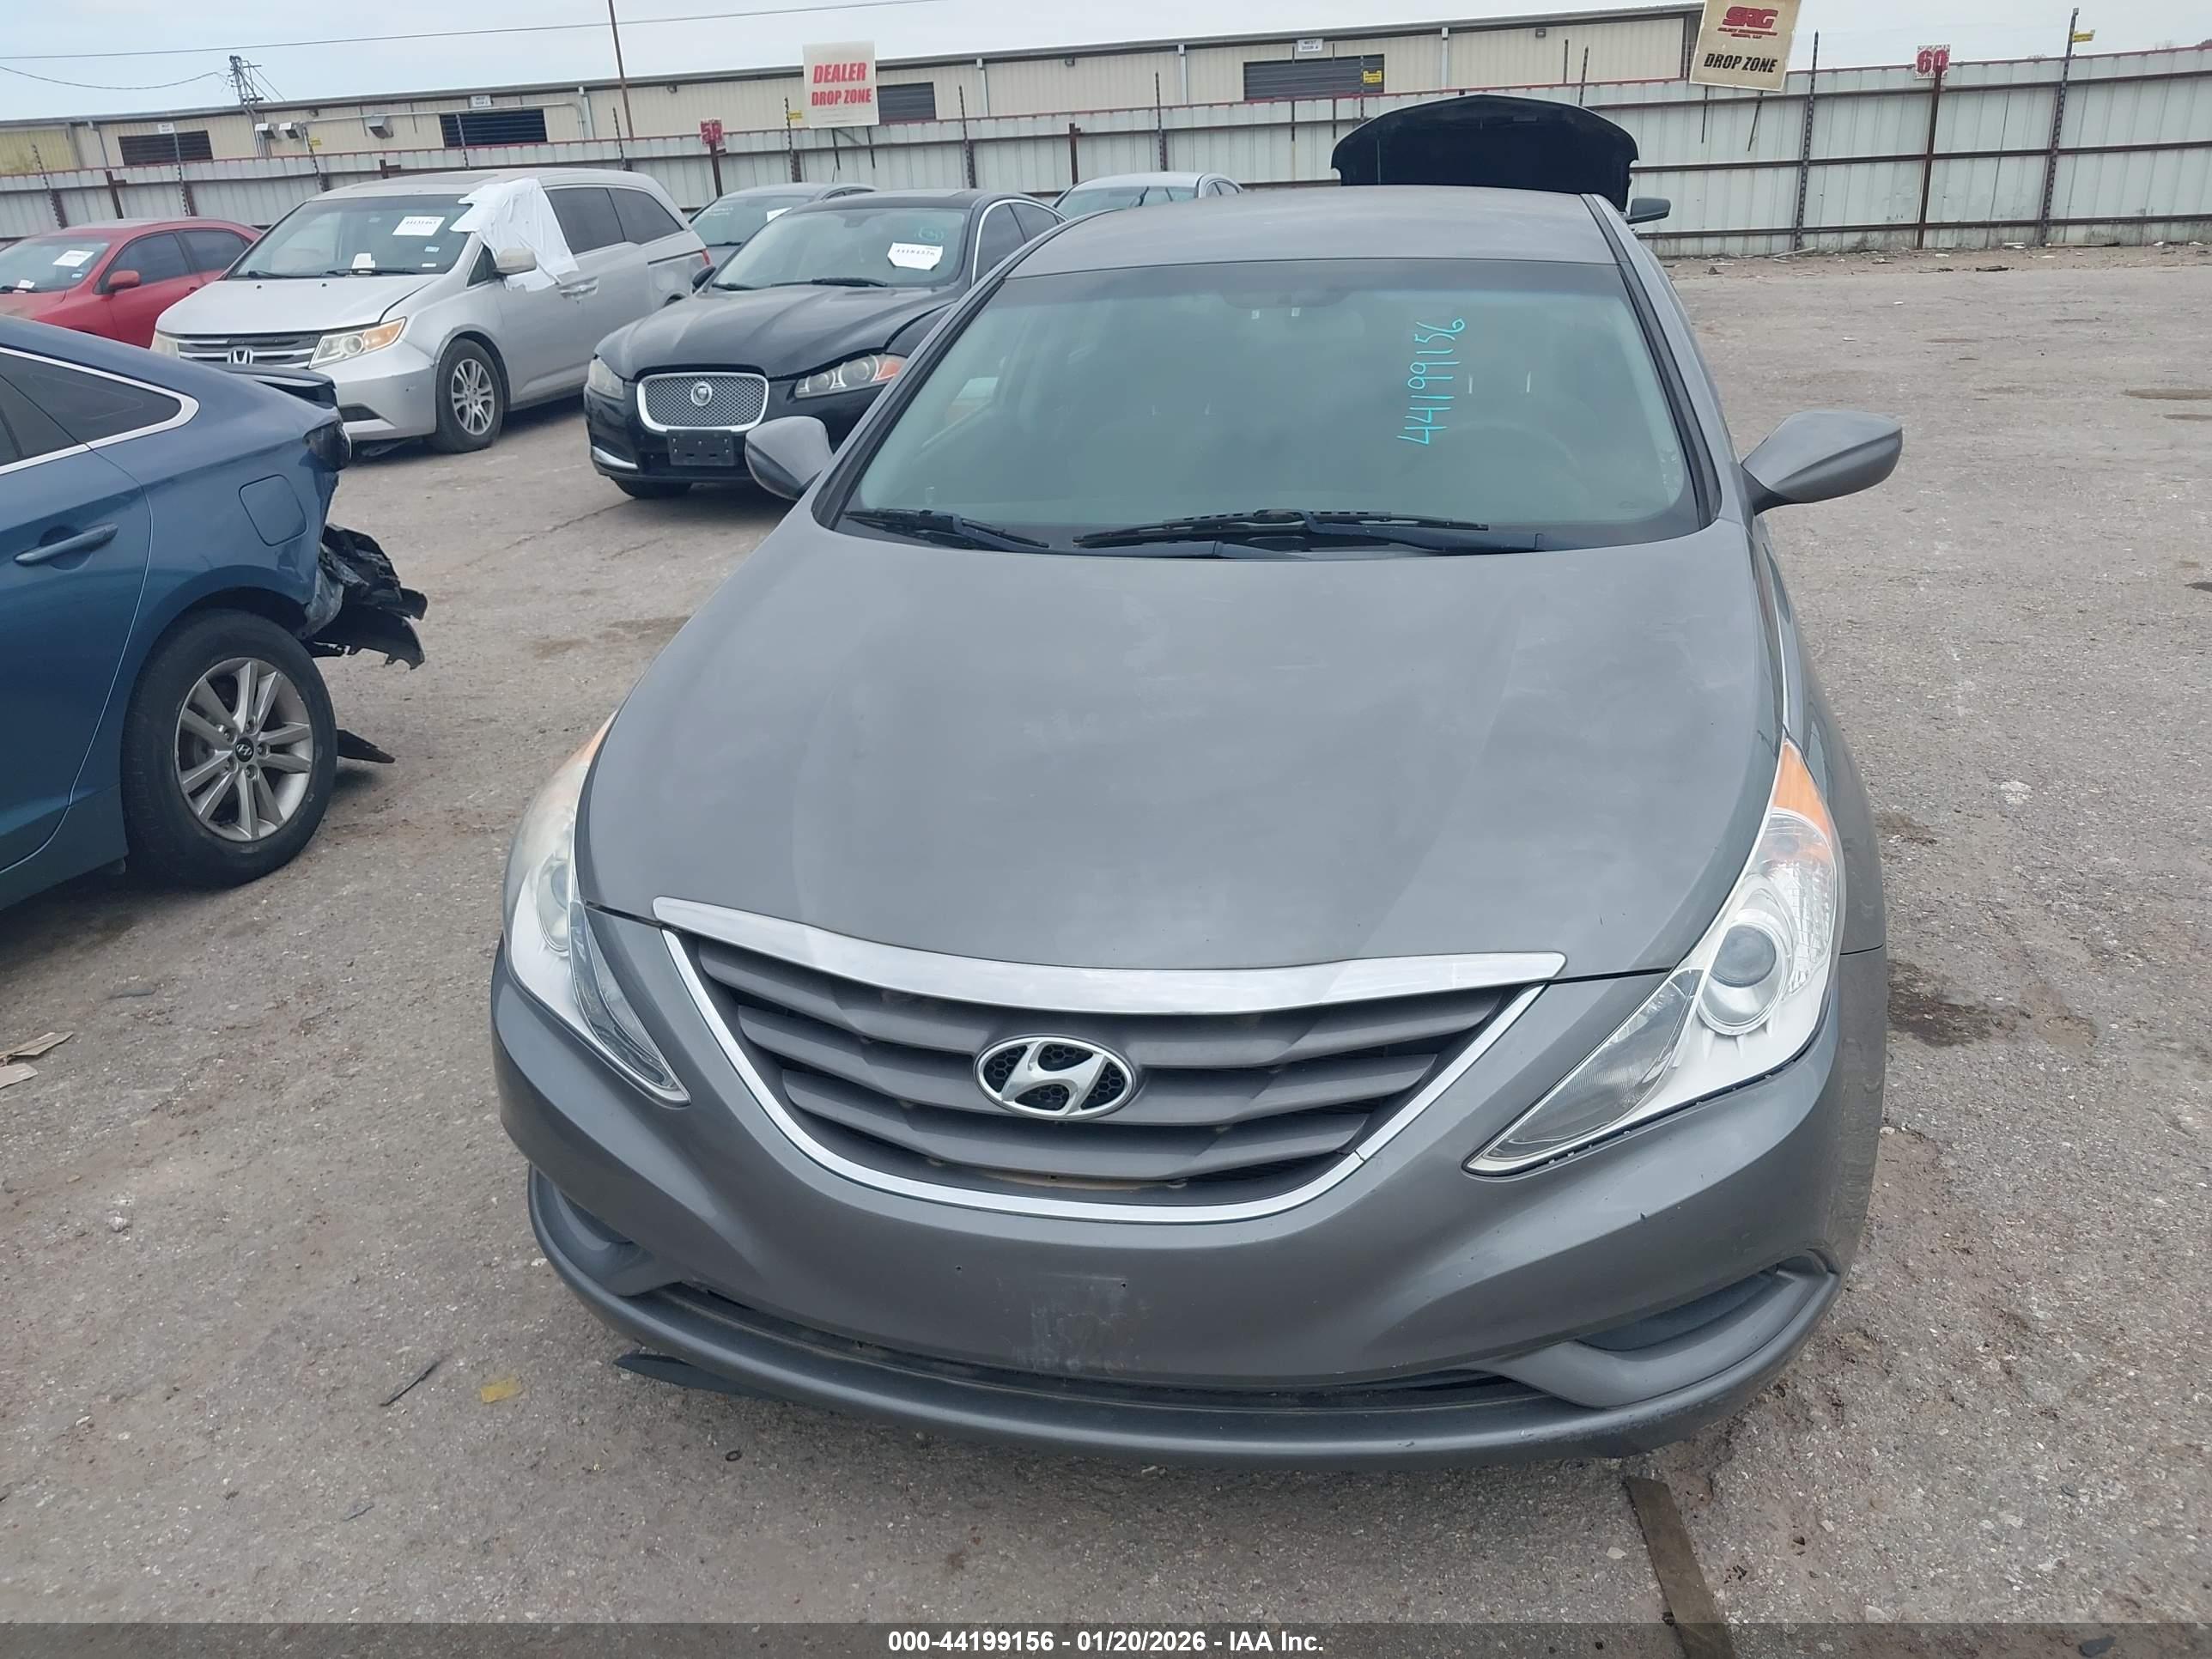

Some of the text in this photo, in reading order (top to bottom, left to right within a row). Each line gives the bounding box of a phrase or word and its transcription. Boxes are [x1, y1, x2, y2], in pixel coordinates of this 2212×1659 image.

[1722, 6, 1779, 29] SRG
[1703, 53, 1778, 73] DROP ZONE
[1917, 49, 1948, 74] 60
[812, 62, 867, 84] DEALER
[811, 88, 872, 106] DROP ZONE
[1396, 318, 1465, 445] 44199156
